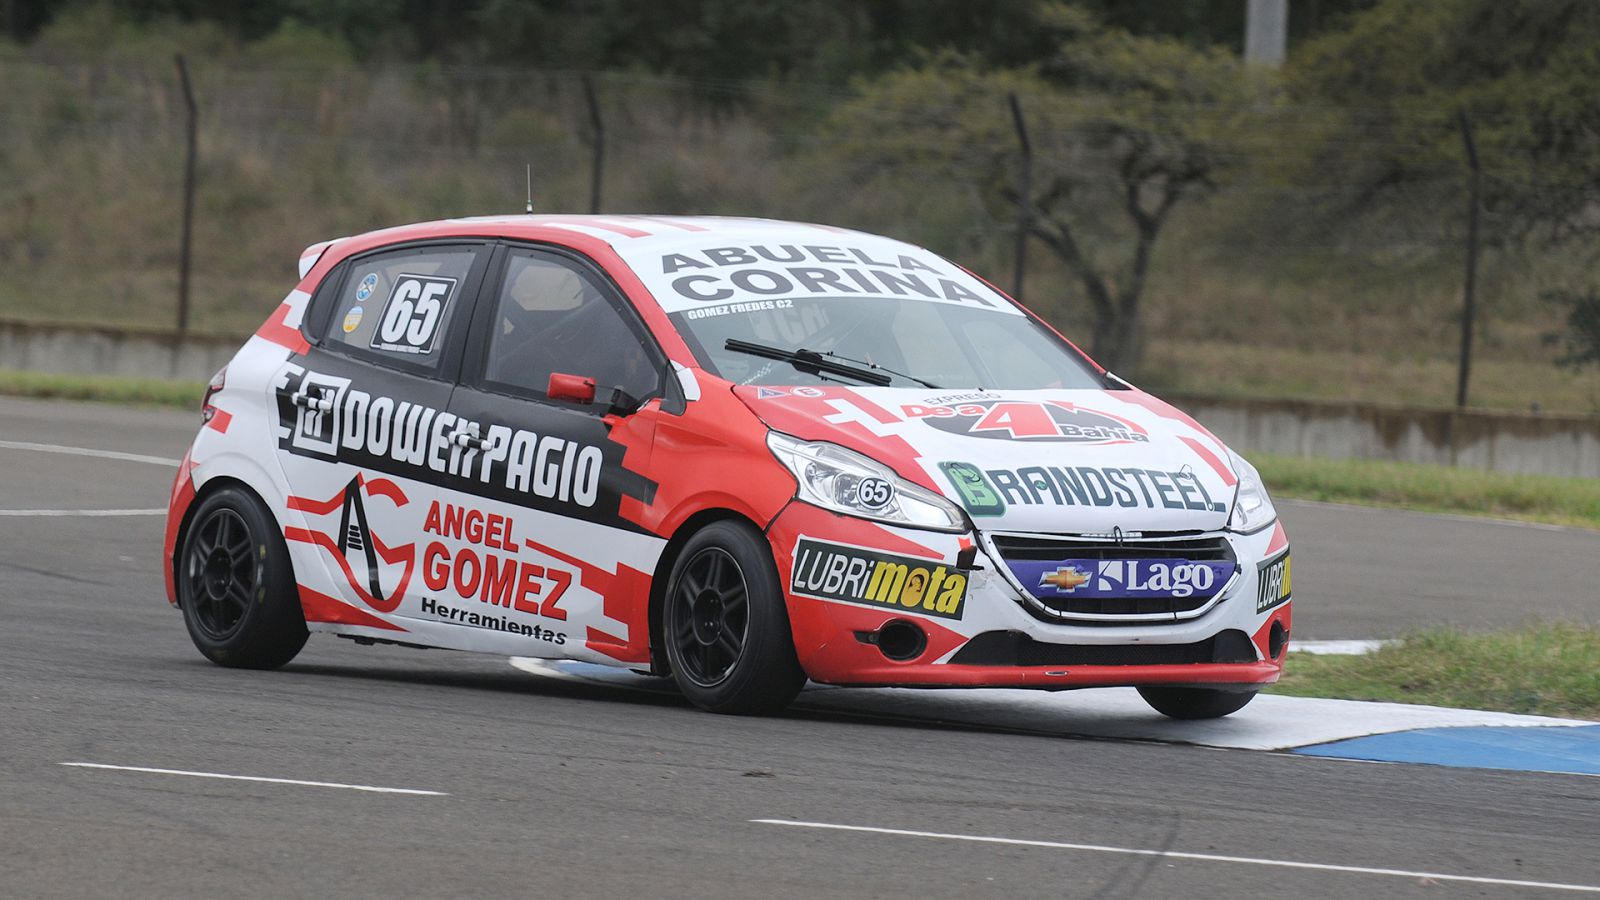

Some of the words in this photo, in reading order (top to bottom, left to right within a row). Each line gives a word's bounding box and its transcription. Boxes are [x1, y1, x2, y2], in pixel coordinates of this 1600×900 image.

[662, 244, 945, 276] ABUELA
[671, 266, 997, 308] CORINA
[380, 279, 448, 346] 65
[687, 305, 730, 320] GOMEZ
[731, 300, 775, 314] FREDES
[776, 299, 794, 309] C2
[922, 390, 1003, 406] EXPRESO
[1057, 424, 1150, 443] Bahia
[479, 424, 604, 508] PAGIO
[859, 480, 890, 508] 65
[938, 460, 1227, 517] BRANDSTEEL
[423, 500, 519, 553] ANGEL
[422, 541, 573, 621] GOMEZ
[1125, 560, 1215, 597] Lago
[421, 597, 568, 646] Herramientas
